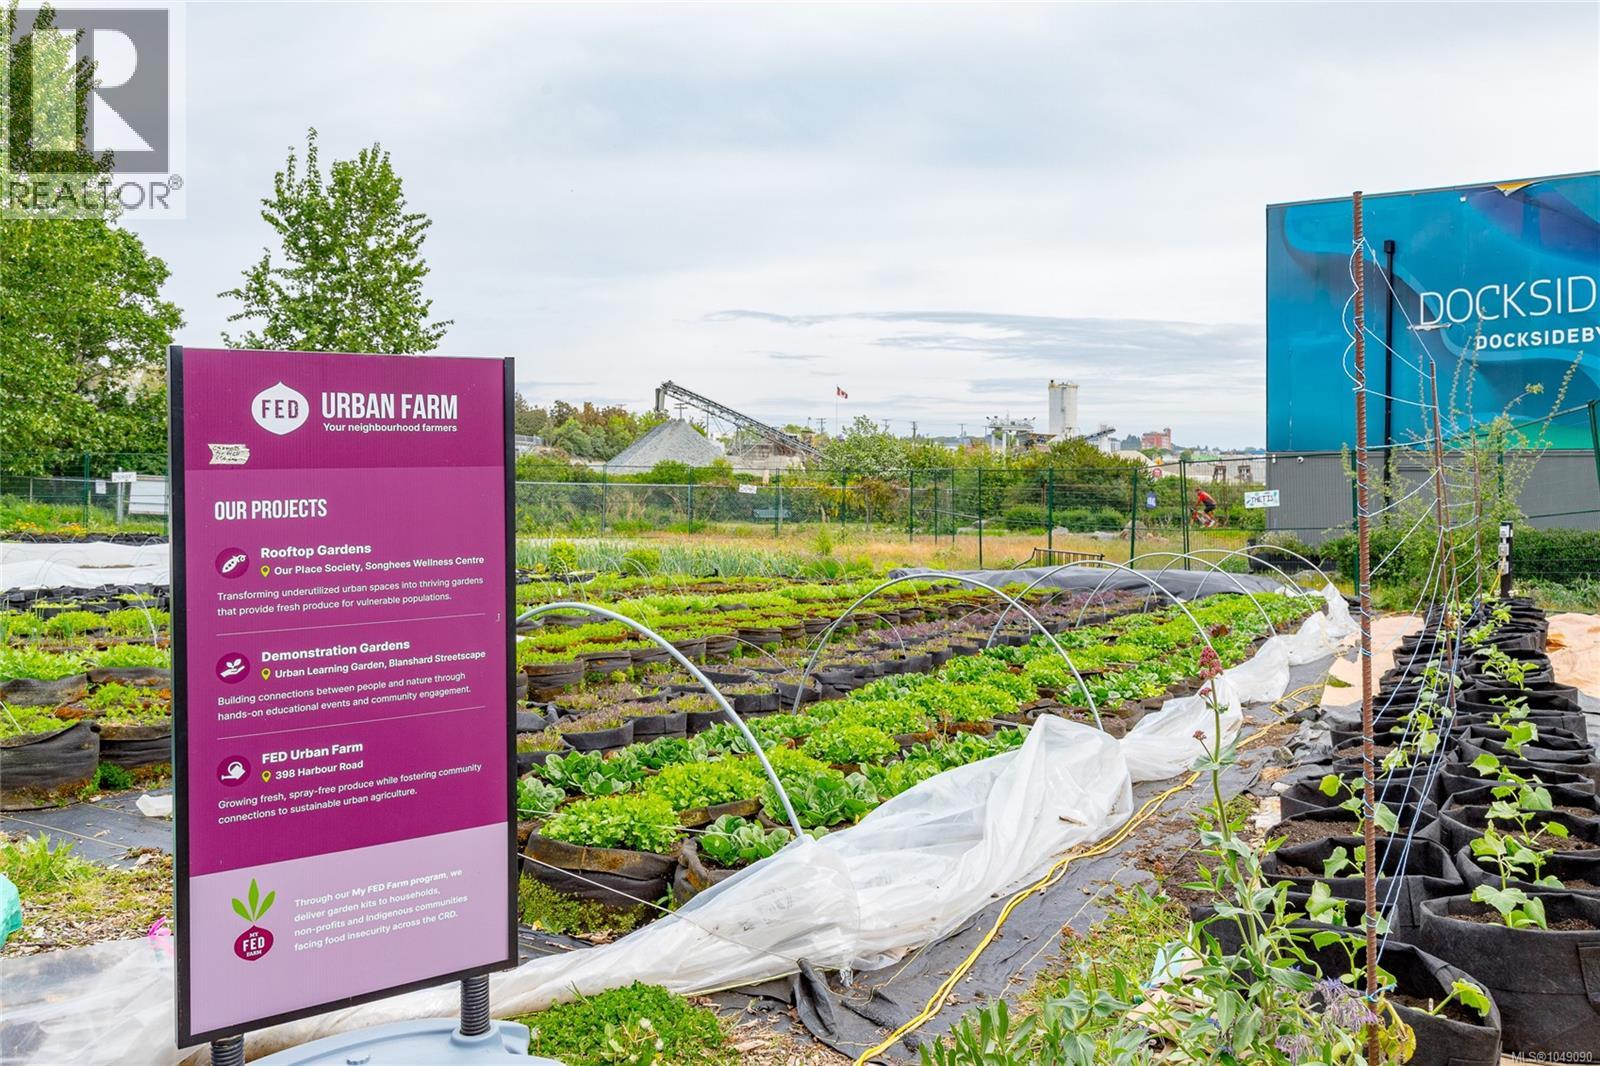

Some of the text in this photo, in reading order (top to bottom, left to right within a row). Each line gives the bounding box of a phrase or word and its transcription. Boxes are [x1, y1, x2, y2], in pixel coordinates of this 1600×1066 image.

[262, 400, 299, 419] FED
[322, 392, 458, 420] URBAN FARM
[323, 423, 458, 434] Your neighbourhood farmers
[214, 499, 328, 520] OUR PROJECTS
[261, 544, 372, 558] Rooftop Gardens
[274, 556, 484, 576] Our Place Society, Songhees Wellness Centre
[217, 576, 484, 601] Transforming underutilized urban spaces into thriving gardens
[217, 592, 452, 616] that provide fresh produce for vulnerable populations.
[262, 640, 410, 662] Demonstration Gardens
[274, 651, 486, 678] Urban Learning Garden, Blanshard Streetscape
[218, 672, 466, 706] Building connections between people and nature through
[218, 686, 471, 721] hands-on educational events and community engagement.
[262, 743, 364, 764] FED Urban Farm
[276, 760, 364, 780] 398 Harbour Road
[218, 764, 482, 810] Growing fresh, spray-free produce while fostering community
[218, 788, 417, 824] connections to sustainable urban agriculture.
[294, 870, 462, 907] Through our My FED Farm program, we
[294, 910, 326, 922] deliver
[328, 904, 358, 917] garden
[360, 900, 376, 909] kits
[390, 887, 440, 903] households,
[294, 895, 468, 936] non-profits and Indigenous communities
[294, 910, 458, 952] facing food insecurity across the CRD.
[243, 937, 265, 952] FED
